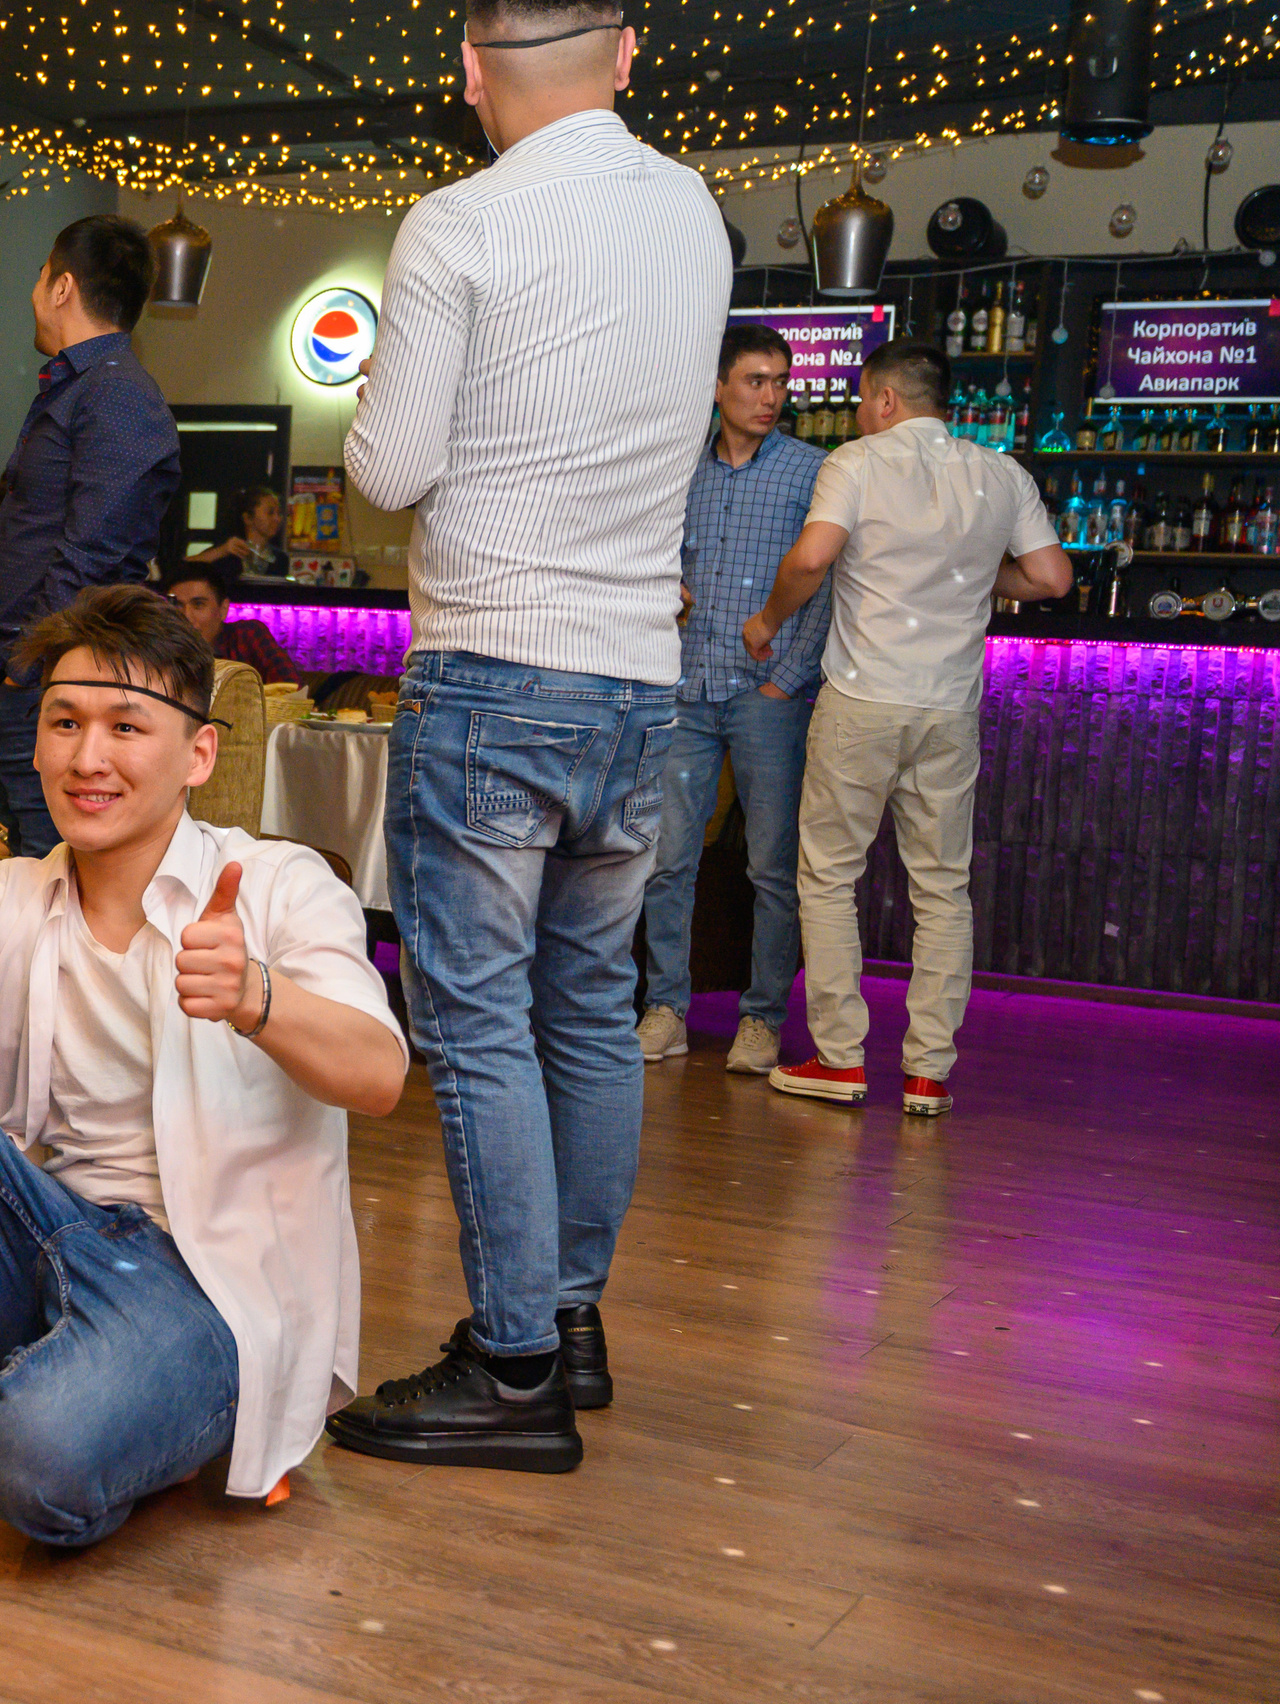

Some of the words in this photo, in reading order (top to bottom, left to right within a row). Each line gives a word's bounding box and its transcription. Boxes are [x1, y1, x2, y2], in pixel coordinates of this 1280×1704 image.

[1133, 319, 1257, 341] Корпоратив
[1127, 346, 1213, 364] Чайхона
[1220, 345, 1257, 364] №1
[1138, 373, 1240, 395] Авиапарк
